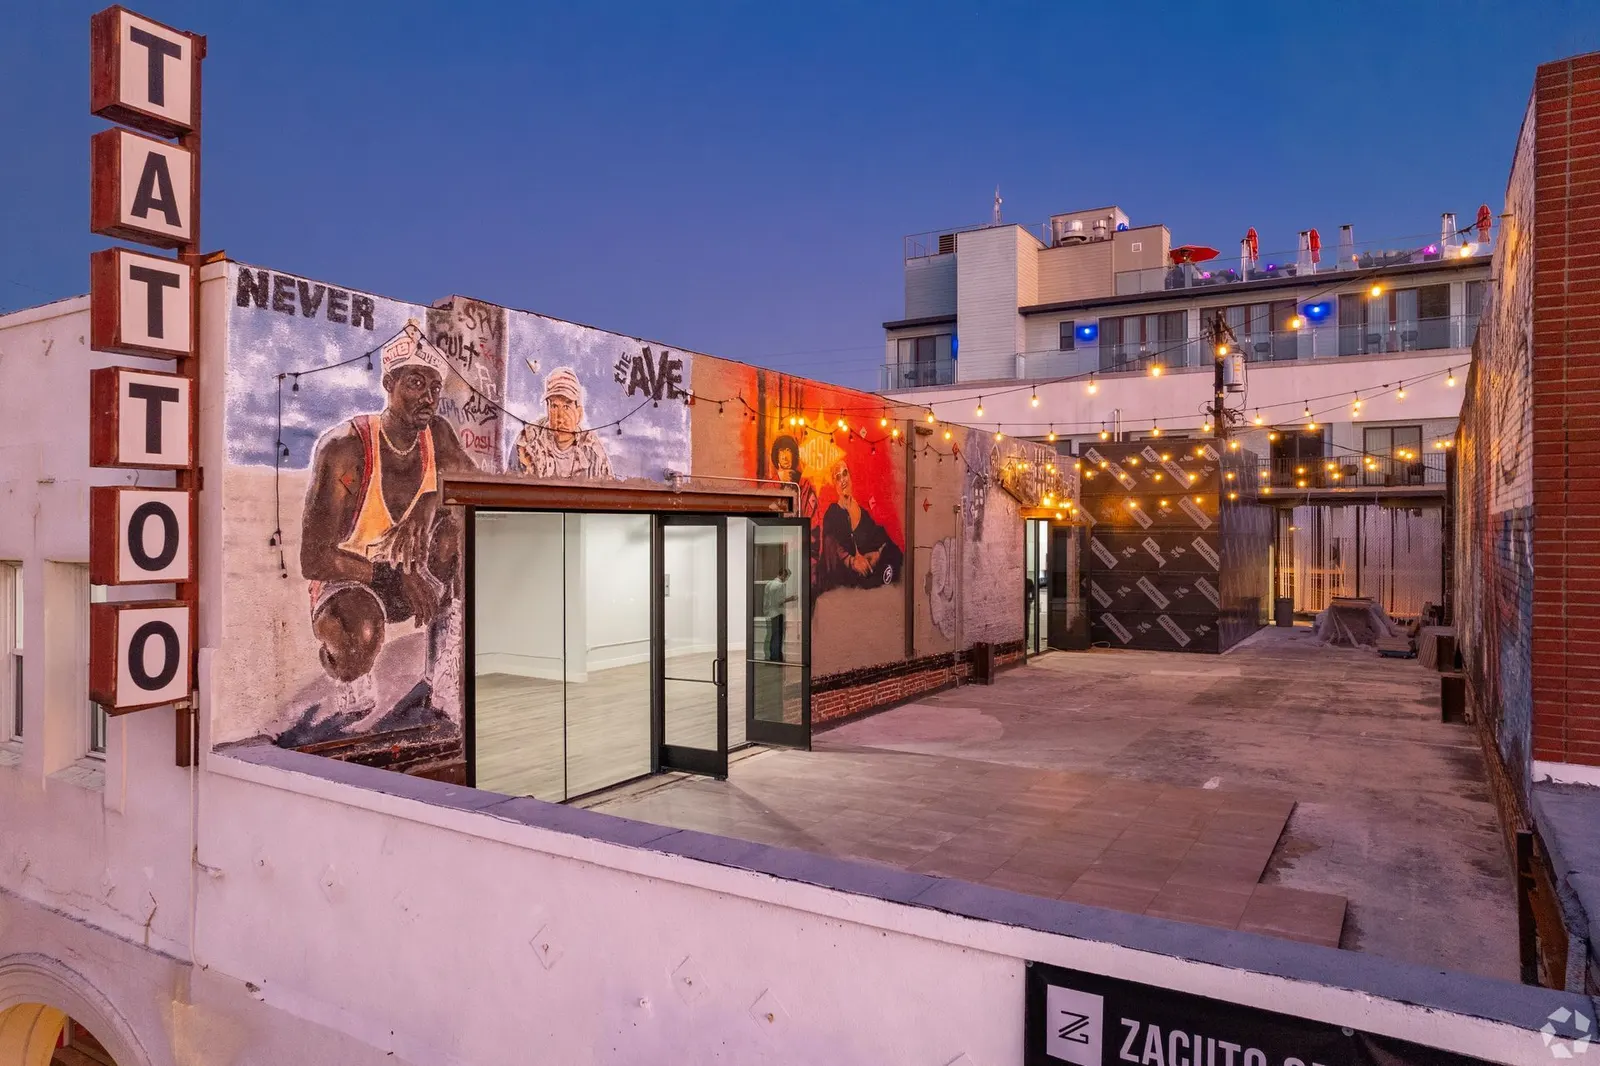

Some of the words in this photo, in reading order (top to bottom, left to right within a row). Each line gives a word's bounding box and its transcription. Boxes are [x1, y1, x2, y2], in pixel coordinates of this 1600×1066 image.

[236, 266, 376, 331] NEVER
[127, 25, 182, 692] TATTOO
[628, 345, 687, 401] AVE
[1139, 579, 1165, 605] Bituthene
[1103, 614, 1129, 640] Bituthene
[1160, 616, 1186, 642] Bituthene
